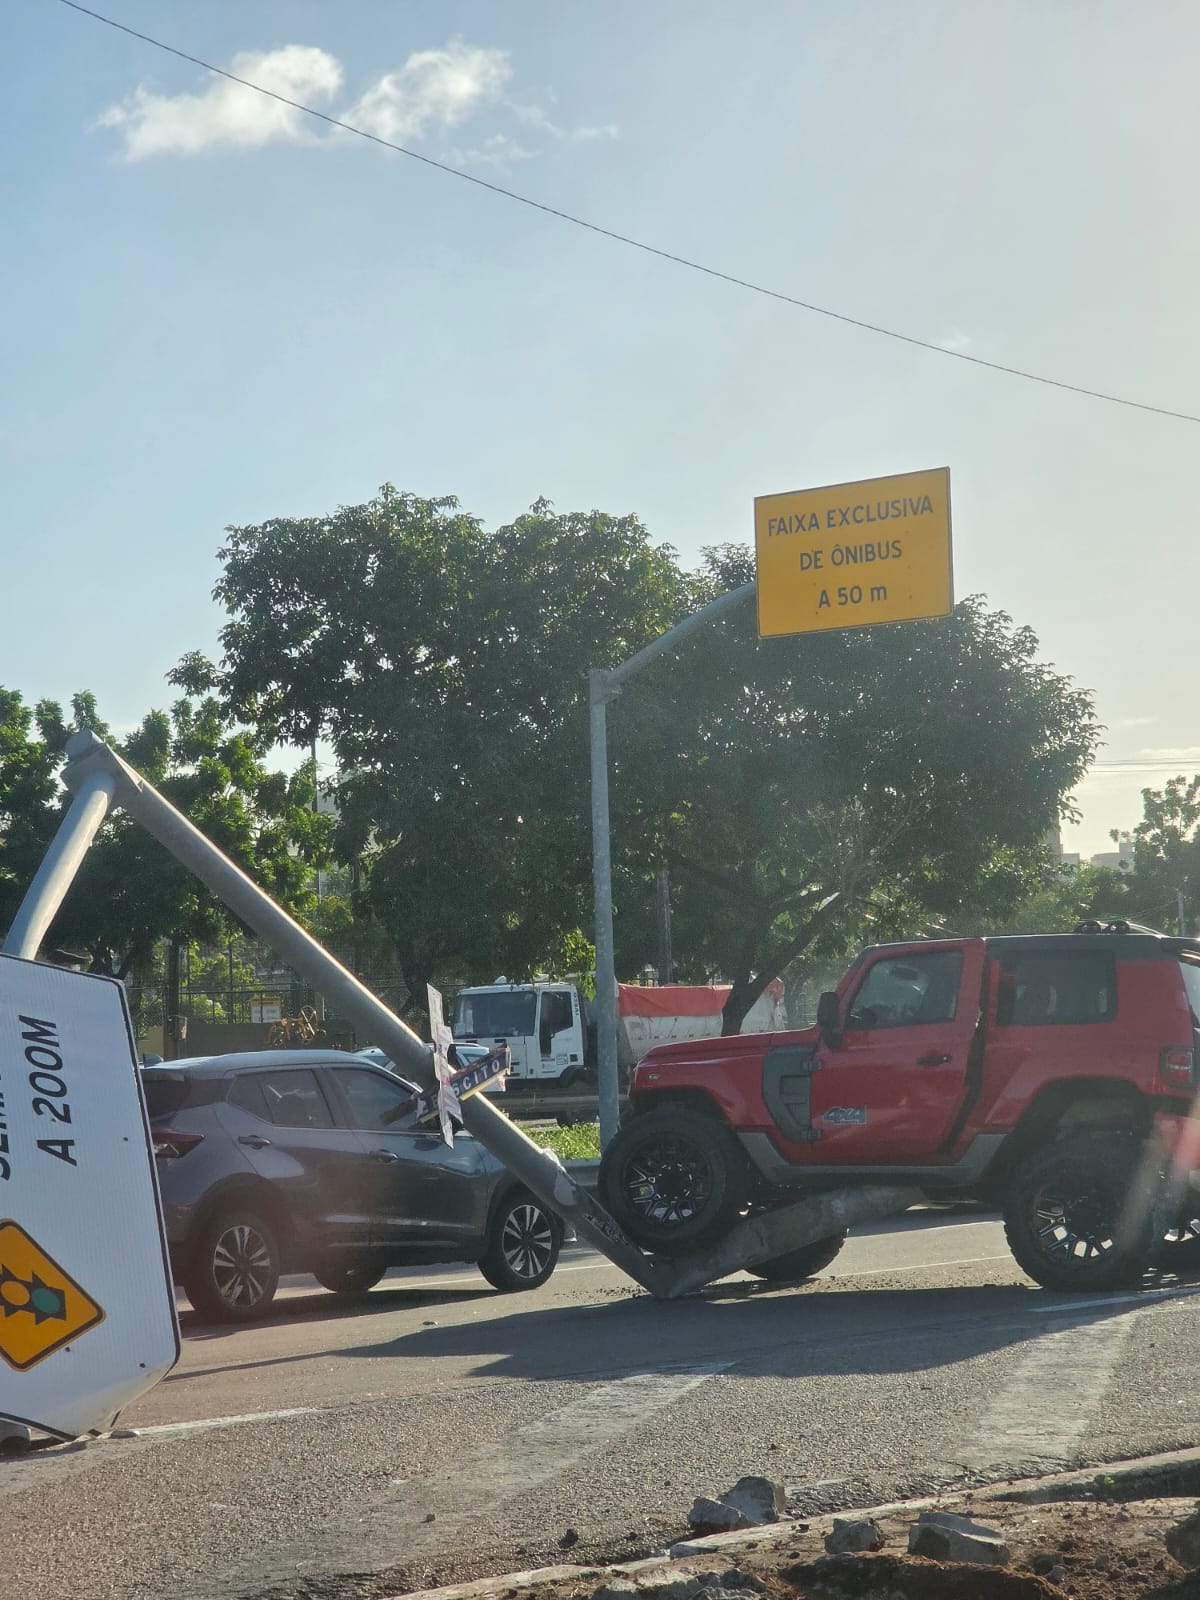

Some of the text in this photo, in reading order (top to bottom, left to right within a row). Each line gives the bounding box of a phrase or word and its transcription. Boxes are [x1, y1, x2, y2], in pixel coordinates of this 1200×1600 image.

[767, 496, 934, 537] FAIXA EXCLUSIVA
[800, 540, 903, 571] DE ÔNIBUS
[818, 586, 888, 608] A 50 m
[18, 1014, 78, 1167] A 200M
